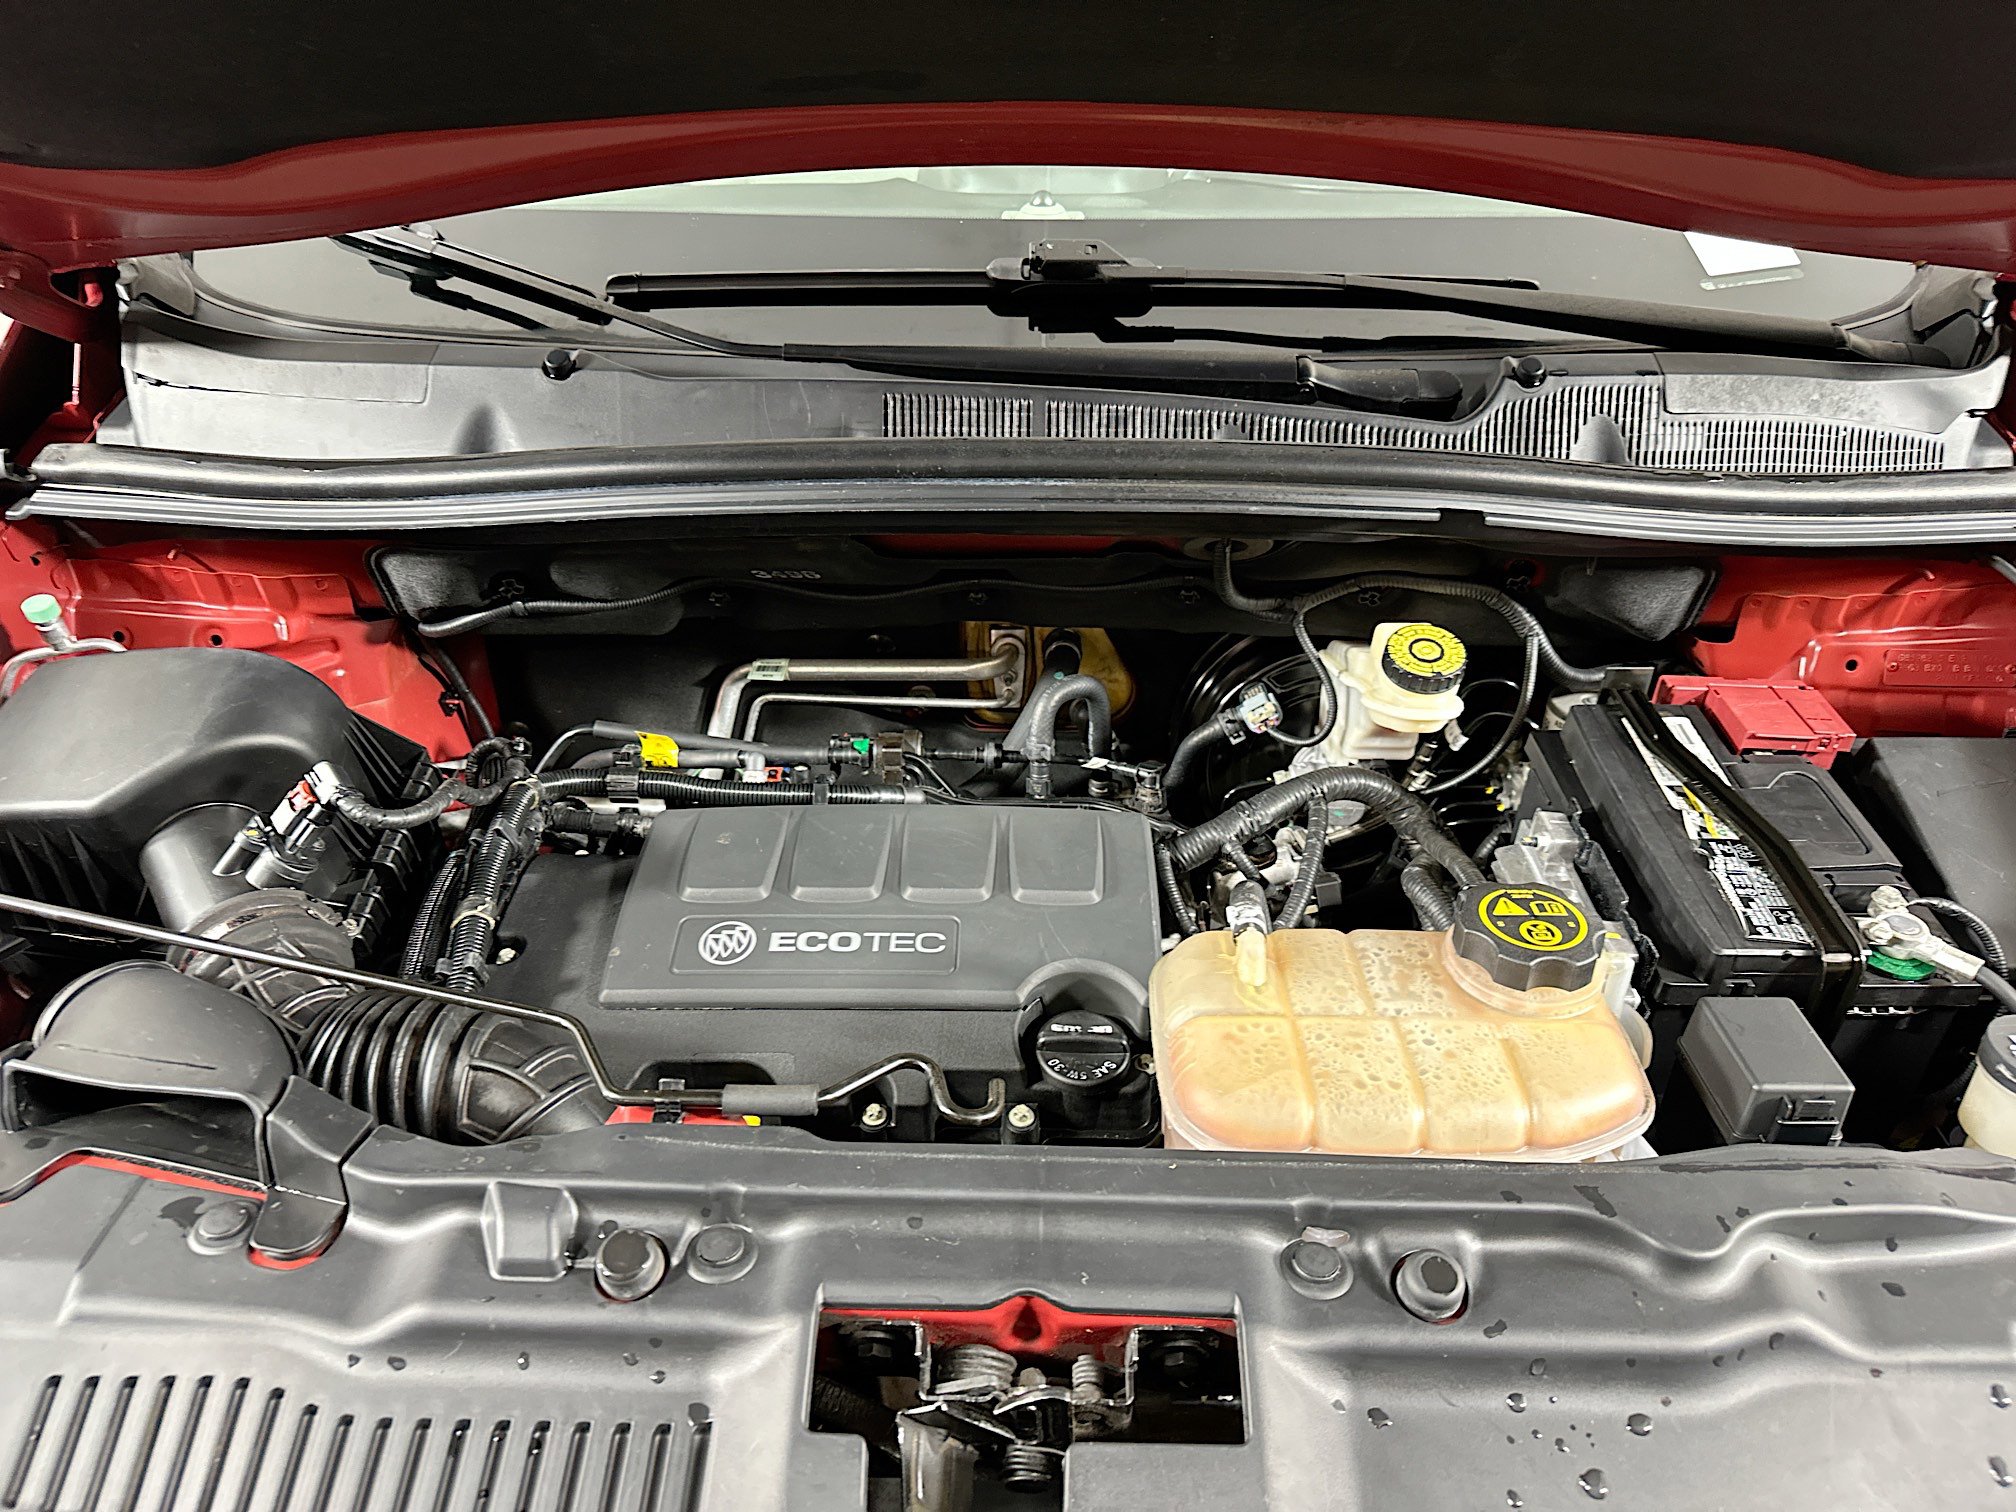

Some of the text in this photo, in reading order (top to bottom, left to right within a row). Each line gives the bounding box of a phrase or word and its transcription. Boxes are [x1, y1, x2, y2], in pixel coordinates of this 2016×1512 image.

[768, 931, 947, 954] ECOTEC
[1047, 1058, 1117, 1080] SAE 5W-30
